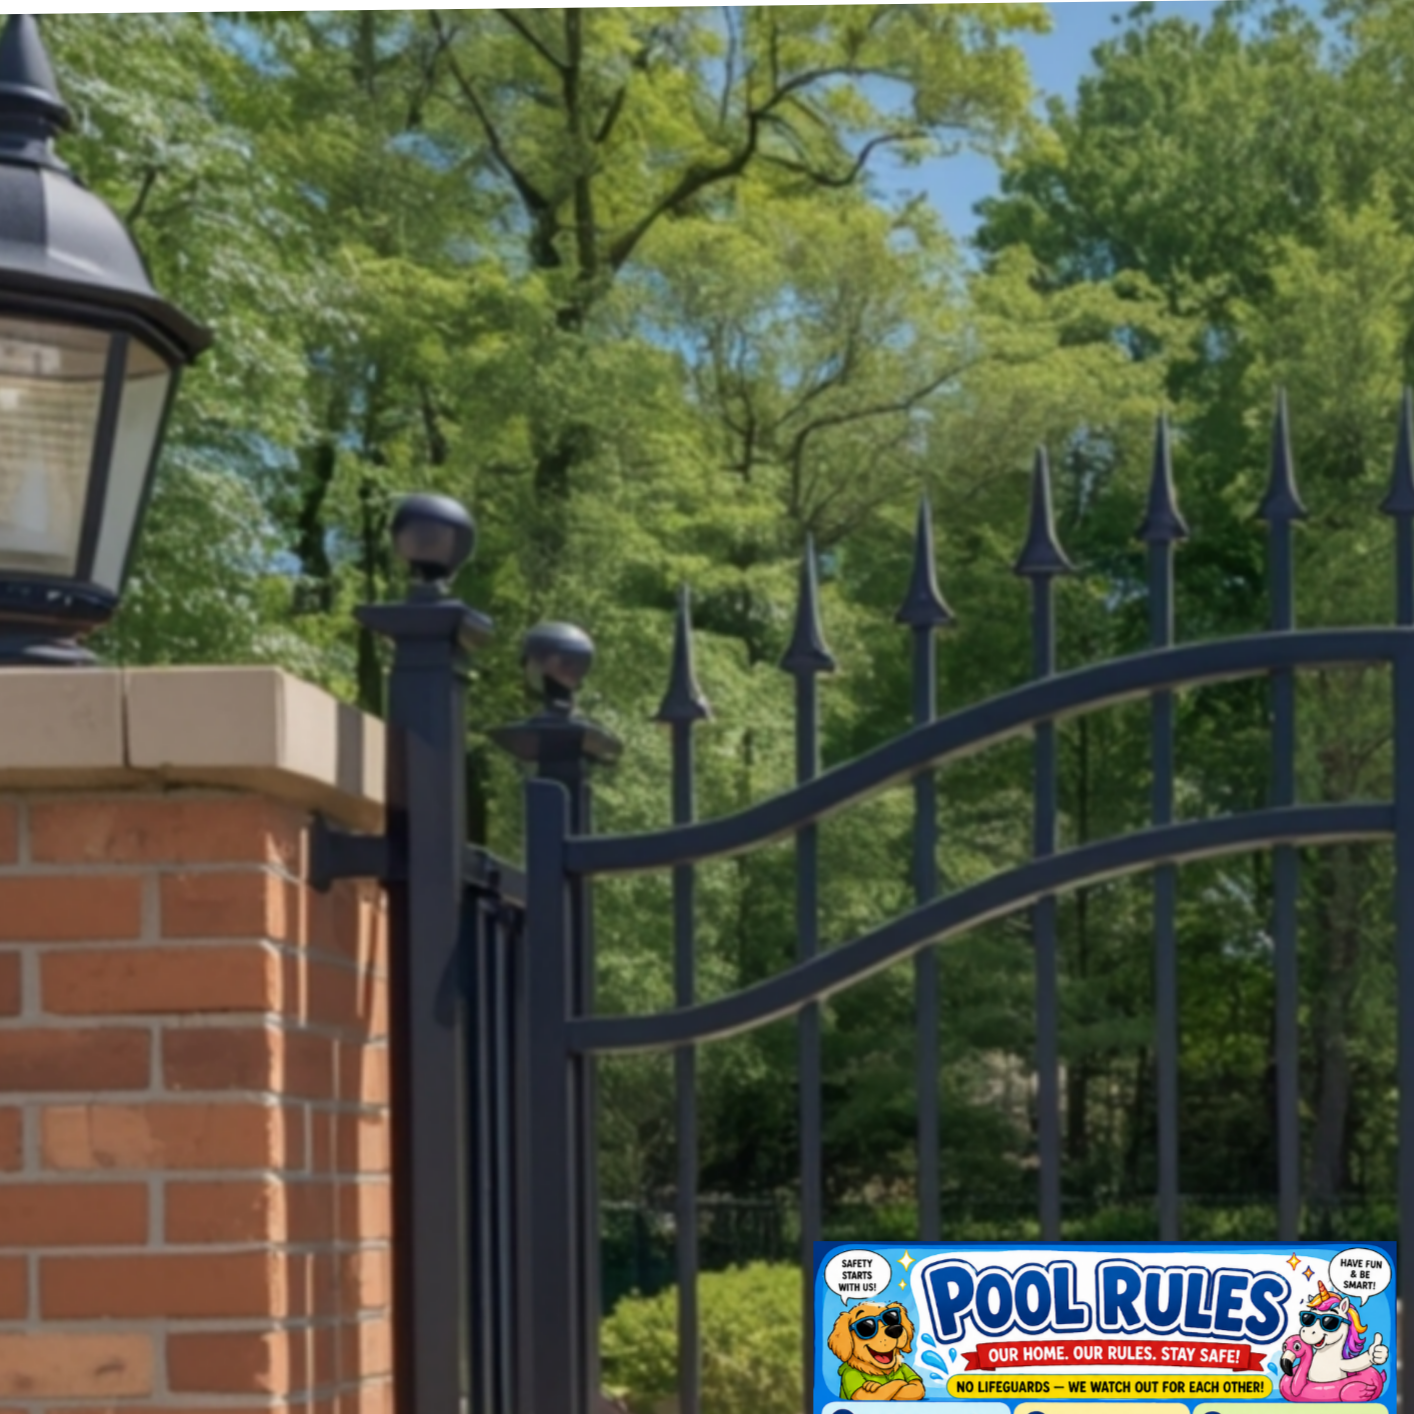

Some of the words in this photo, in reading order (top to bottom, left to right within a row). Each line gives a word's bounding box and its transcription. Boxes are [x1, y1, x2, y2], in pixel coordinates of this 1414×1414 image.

[842, 1259, 872, 1268] SAFETY
[1340, 1259, 1363, 1268] HAVE
[1365, 1260, 1382, 1269] FUN
[842, 1271, 872, 1280] STARTS
[1350, 1270, 1357, 1278] &
[1360, 1271, 1370, 1279] BE
[838, 1283, 859, 1291] WITH
[863, 1283, 876, 1291] US!
[1343, 1281, 1376, 1290] SMART!
[922, 1259, 1092, 1344] POOL
[1095, 1259, 1290, 1344] RULES
[989, 1348, 1018, 1362] OUR
[1023, 1346, 1069, 1361] HOME.
[1073, 1346, 1102, 1360] OUR
[1108, 1346, 1156, 1360] RULES.
[1161, 1347, 1195, 1361] STAY
[1200, 1348, 1240, 1363] SAFE!
[957, 1381, 973, 1393] NO
[978, 1381, 1050, 1393] LIFEGUARDS
[1068, 1381, 1086, 1392] WE
[1090, 1381, 1131, 1392] WATCH
[1135, 1381, 1158, 1392] OUT
[1162, 1381, 1185, 1392] FOR
[1189, 1381, 1219, 1392] EACH
[1223, 1381, 1264, 1392] OTHER!
